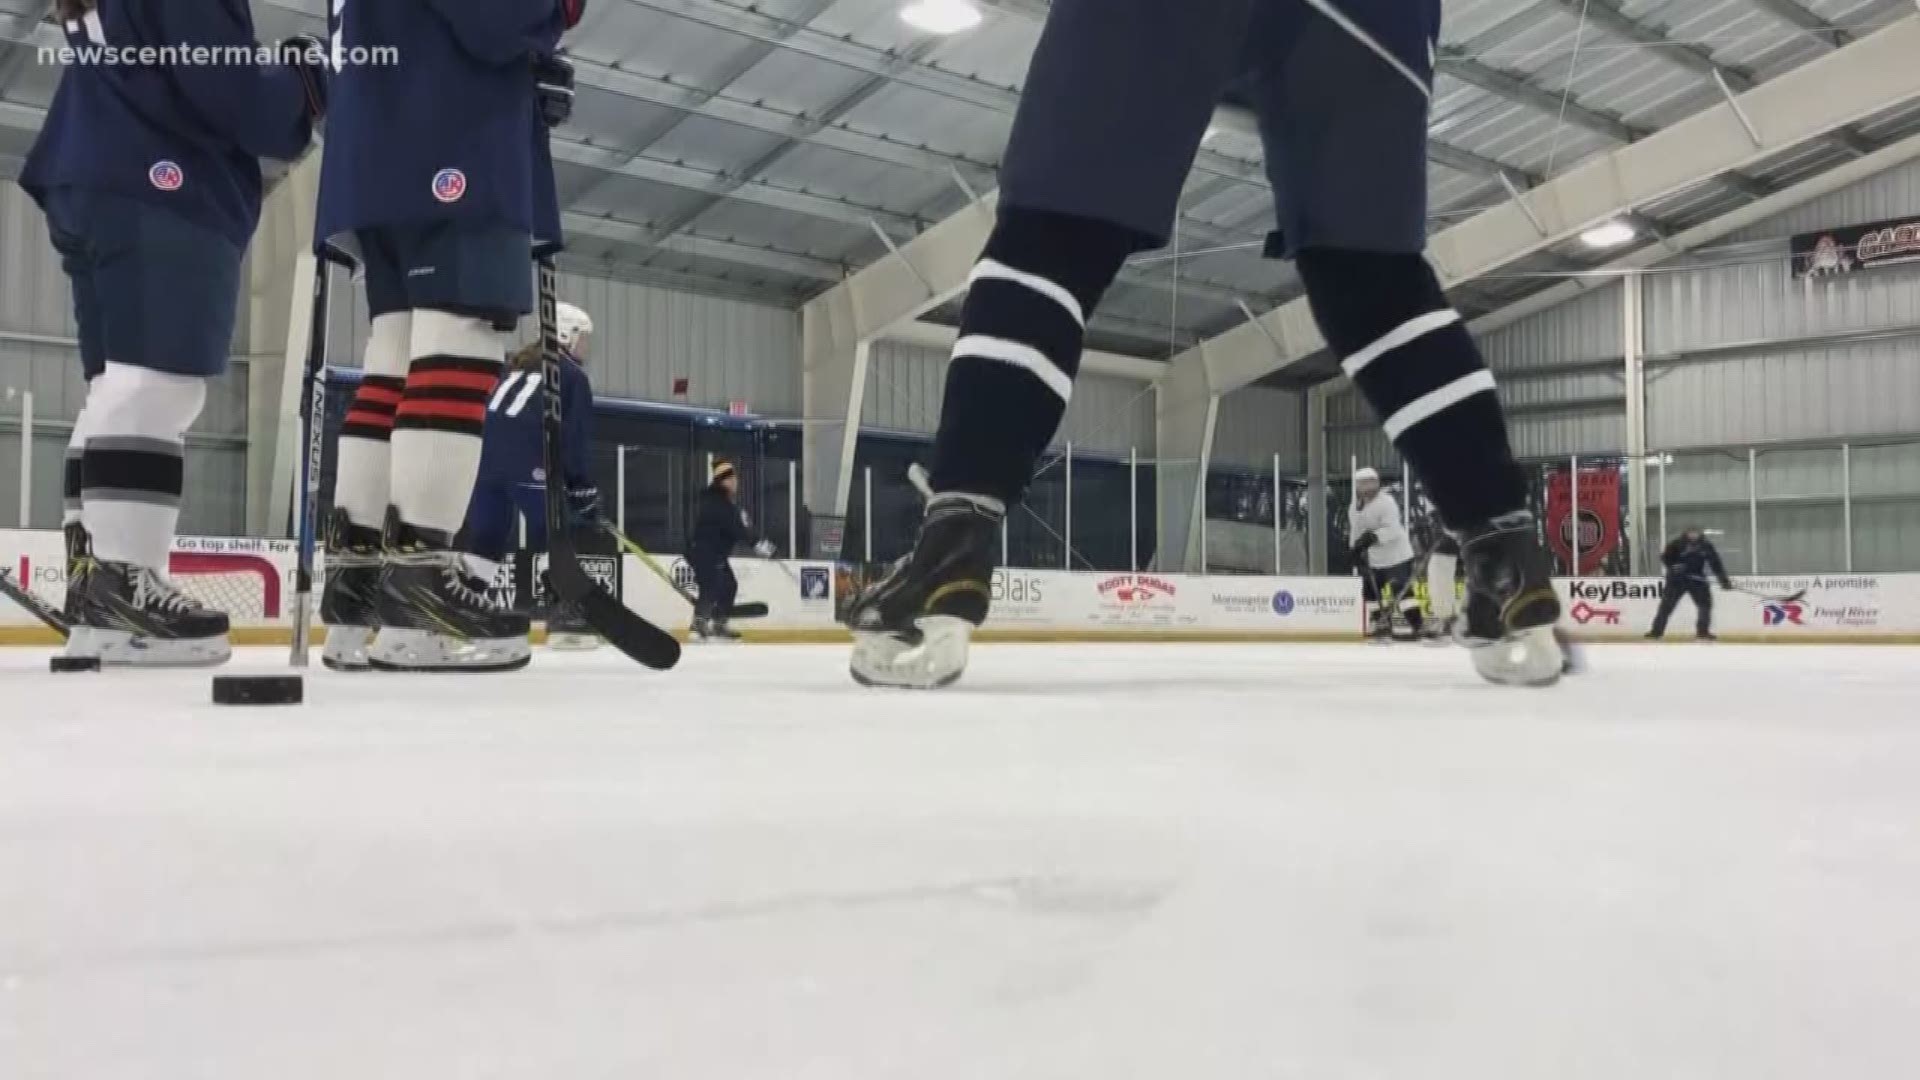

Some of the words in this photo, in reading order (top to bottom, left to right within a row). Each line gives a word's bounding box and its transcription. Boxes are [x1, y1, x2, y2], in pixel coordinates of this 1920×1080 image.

[541, 263, 562, 422] BAUER
[489, 371, 542, 418] 11
[311, 390, 324, 483] NEXUS
[177, 538, 196, 548] Go
[201, 539, 224, 552] top
[269, 541, 288, 551] For
[990, 570, 1042, 602] Blais
[1813, 576, 1822, 588] A
